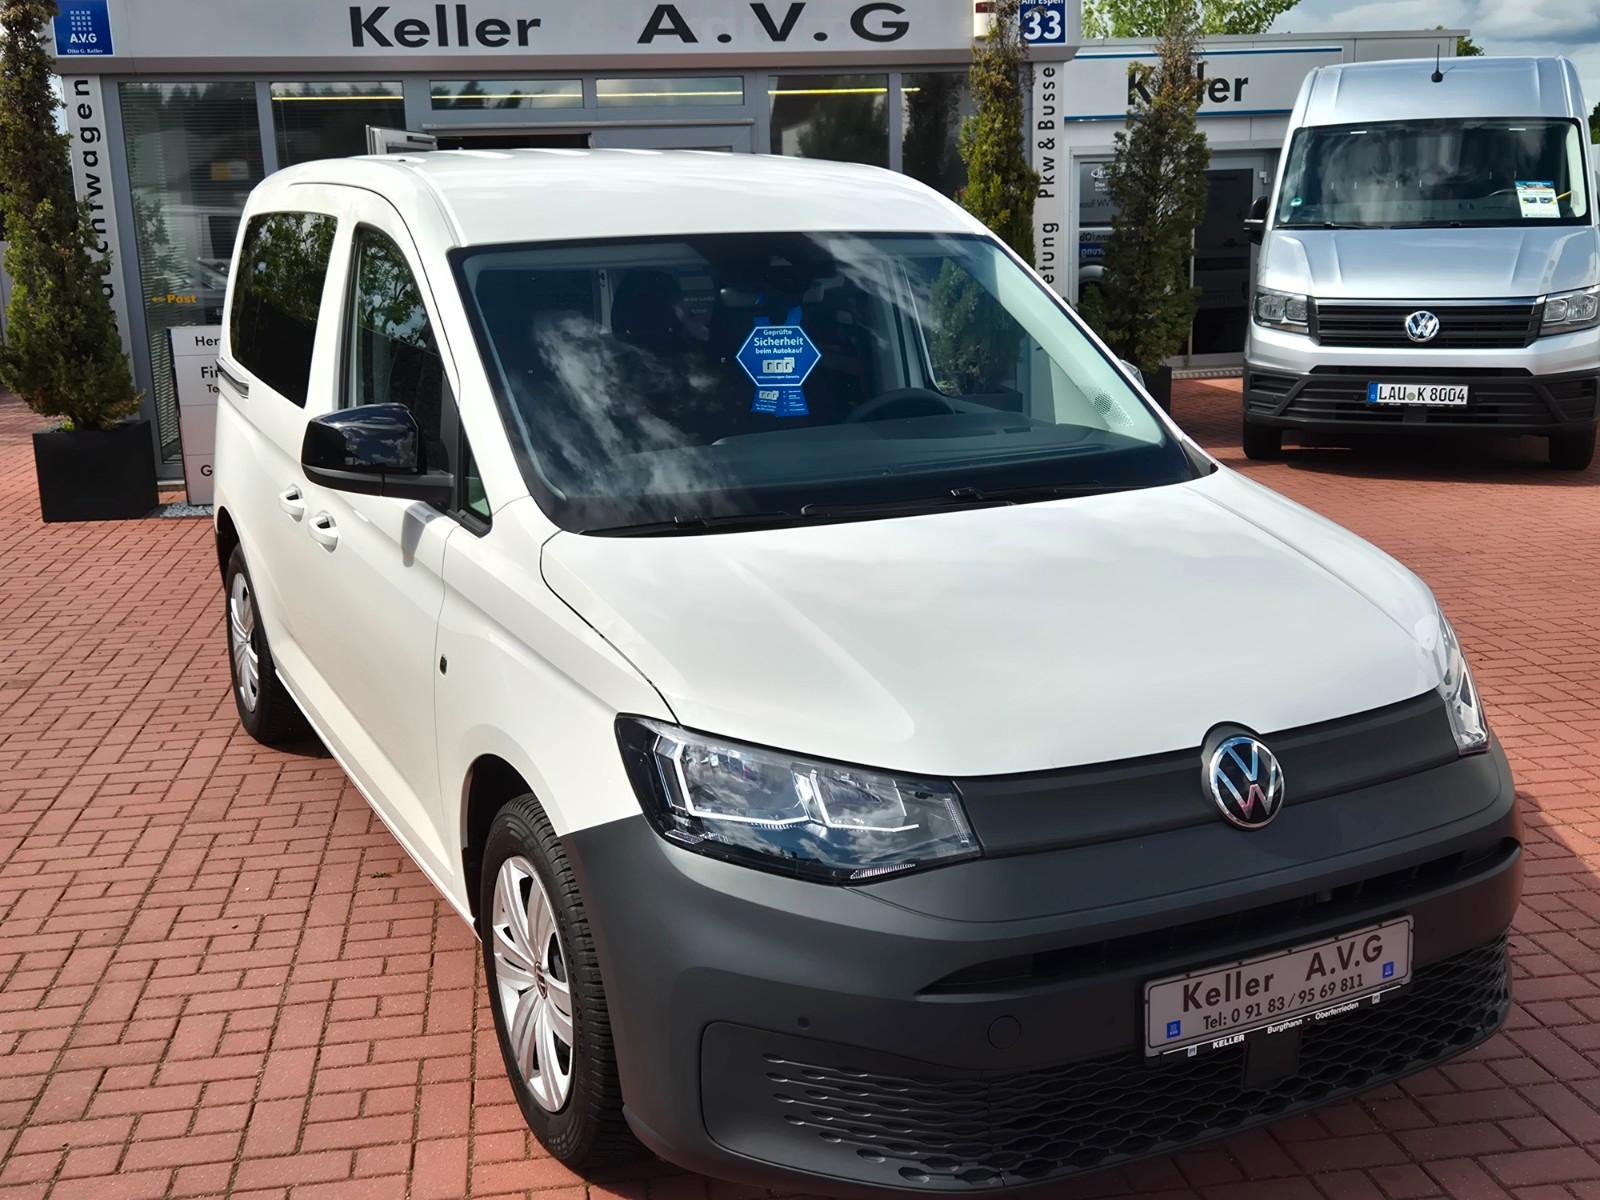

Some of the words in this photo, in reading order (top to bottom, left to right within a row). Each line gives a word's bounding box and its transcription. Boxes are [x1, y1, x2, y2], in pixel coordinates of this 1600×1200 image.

[69, 32, 98, 43] A.V.G
[349, 4, 541, 47] Keller
[1023, 10, 1062, 41] 33
[1037, 66, 1056, 131] Busse
[1127, 62, 1249, 106] Kler
[1038, 137, 1056, 151] &
[1037, 155, 1056, 199] Pkw
[166, 294, 197, 304] Post
[754, 337, 804, 346] Sicherheit
[763, 329, 793, 337] Geprüfte
[1379, 386, 1407, 401] LAU
[1417, 387, 1426, 401] K
[1430, 387, 1465, 403] 8004
[1183, 970, 1274, 1013] Keller
[1305, 934, 1383, 982] A.V.G
[1203, 1011, 1227, 1030] Tel:
[1231, 1008, 1241, 1023] 0
[1245, 1003, 1262, 1019] 91
[1320, 982, 1336, 999] 69
[1340, 974, 1364, 993] 811
[1212, 1034, 1245, 1049] KELLER
[1267, 1019, 1303, 1034] Burgthann
